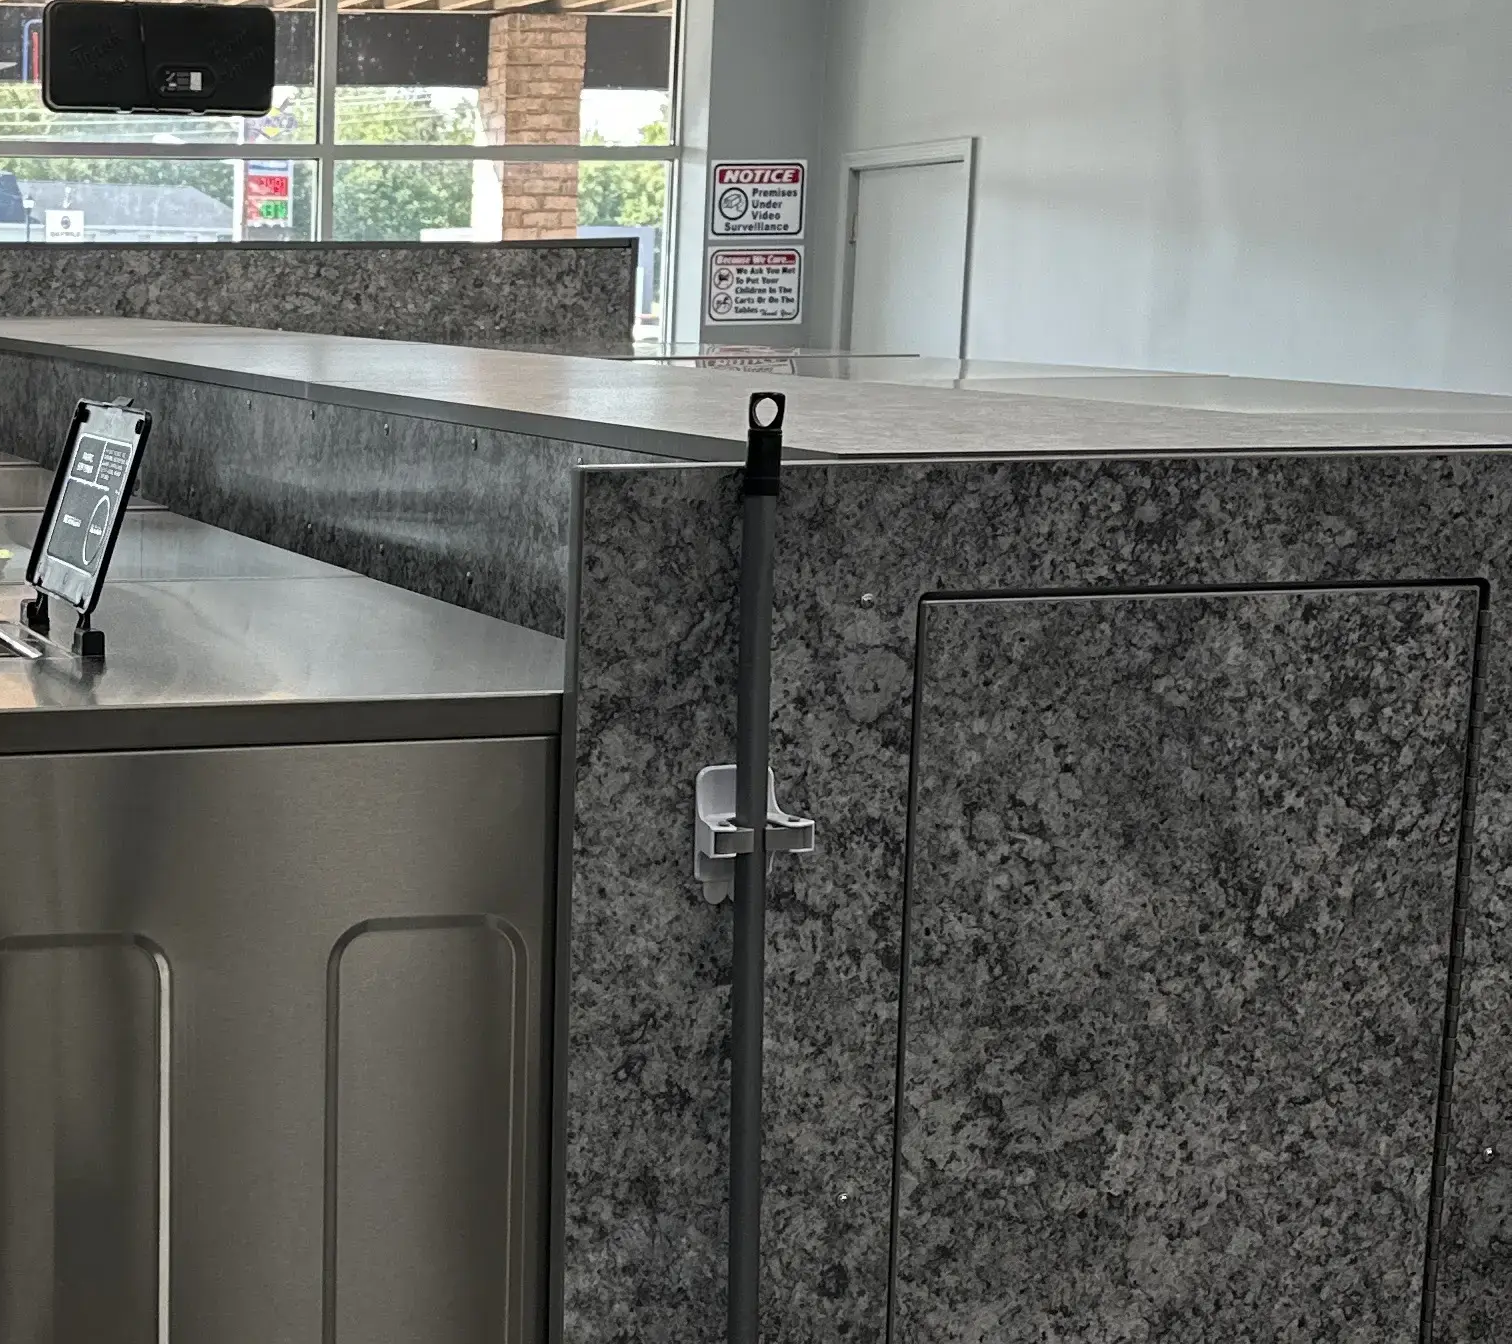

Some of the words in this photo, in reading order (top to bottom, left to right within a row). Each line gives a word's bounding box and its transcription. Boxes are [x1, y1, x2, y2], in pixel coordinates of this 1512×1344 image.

[724, 170, 796, 182] NOTICE
[752, 188, 798, 196] Premises
[752, 200, 782, 208] Under
[751, 211, 780, 220] Video
[724, 222, 789, 231] Surveillance
[734, 296, 754, 304] Carts
[734, 306, 758, 314] Tables
